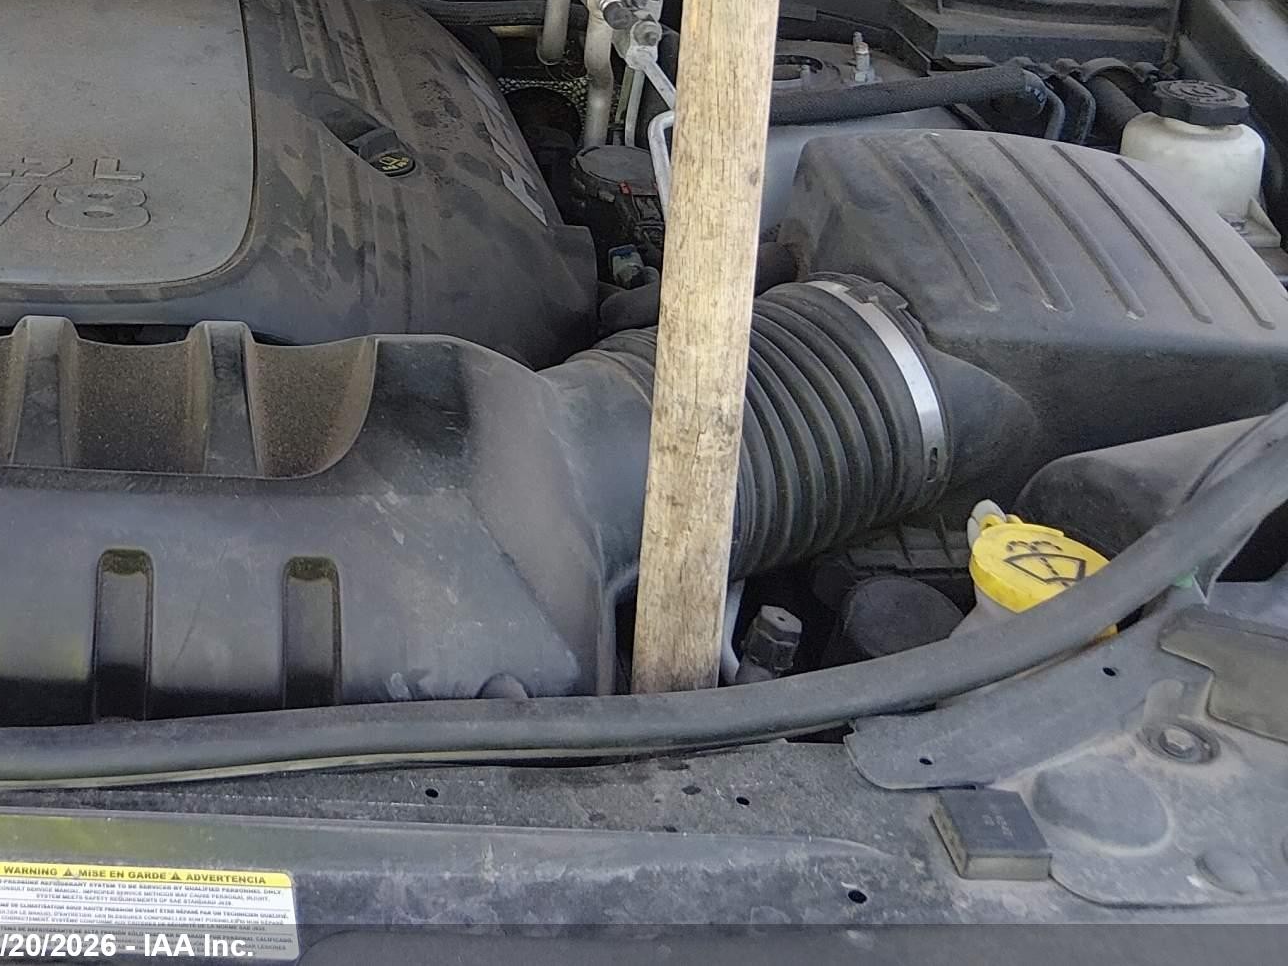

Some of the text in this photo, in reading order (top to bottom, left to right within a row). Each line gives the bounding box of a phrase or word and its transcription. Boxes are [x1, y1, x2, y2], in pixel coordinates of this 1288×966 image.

[3, 865, 58, 876] WARNING
[128, 871, 167, 880] GARDE
[186, 873, 267, 884] ADVERTENCIA
